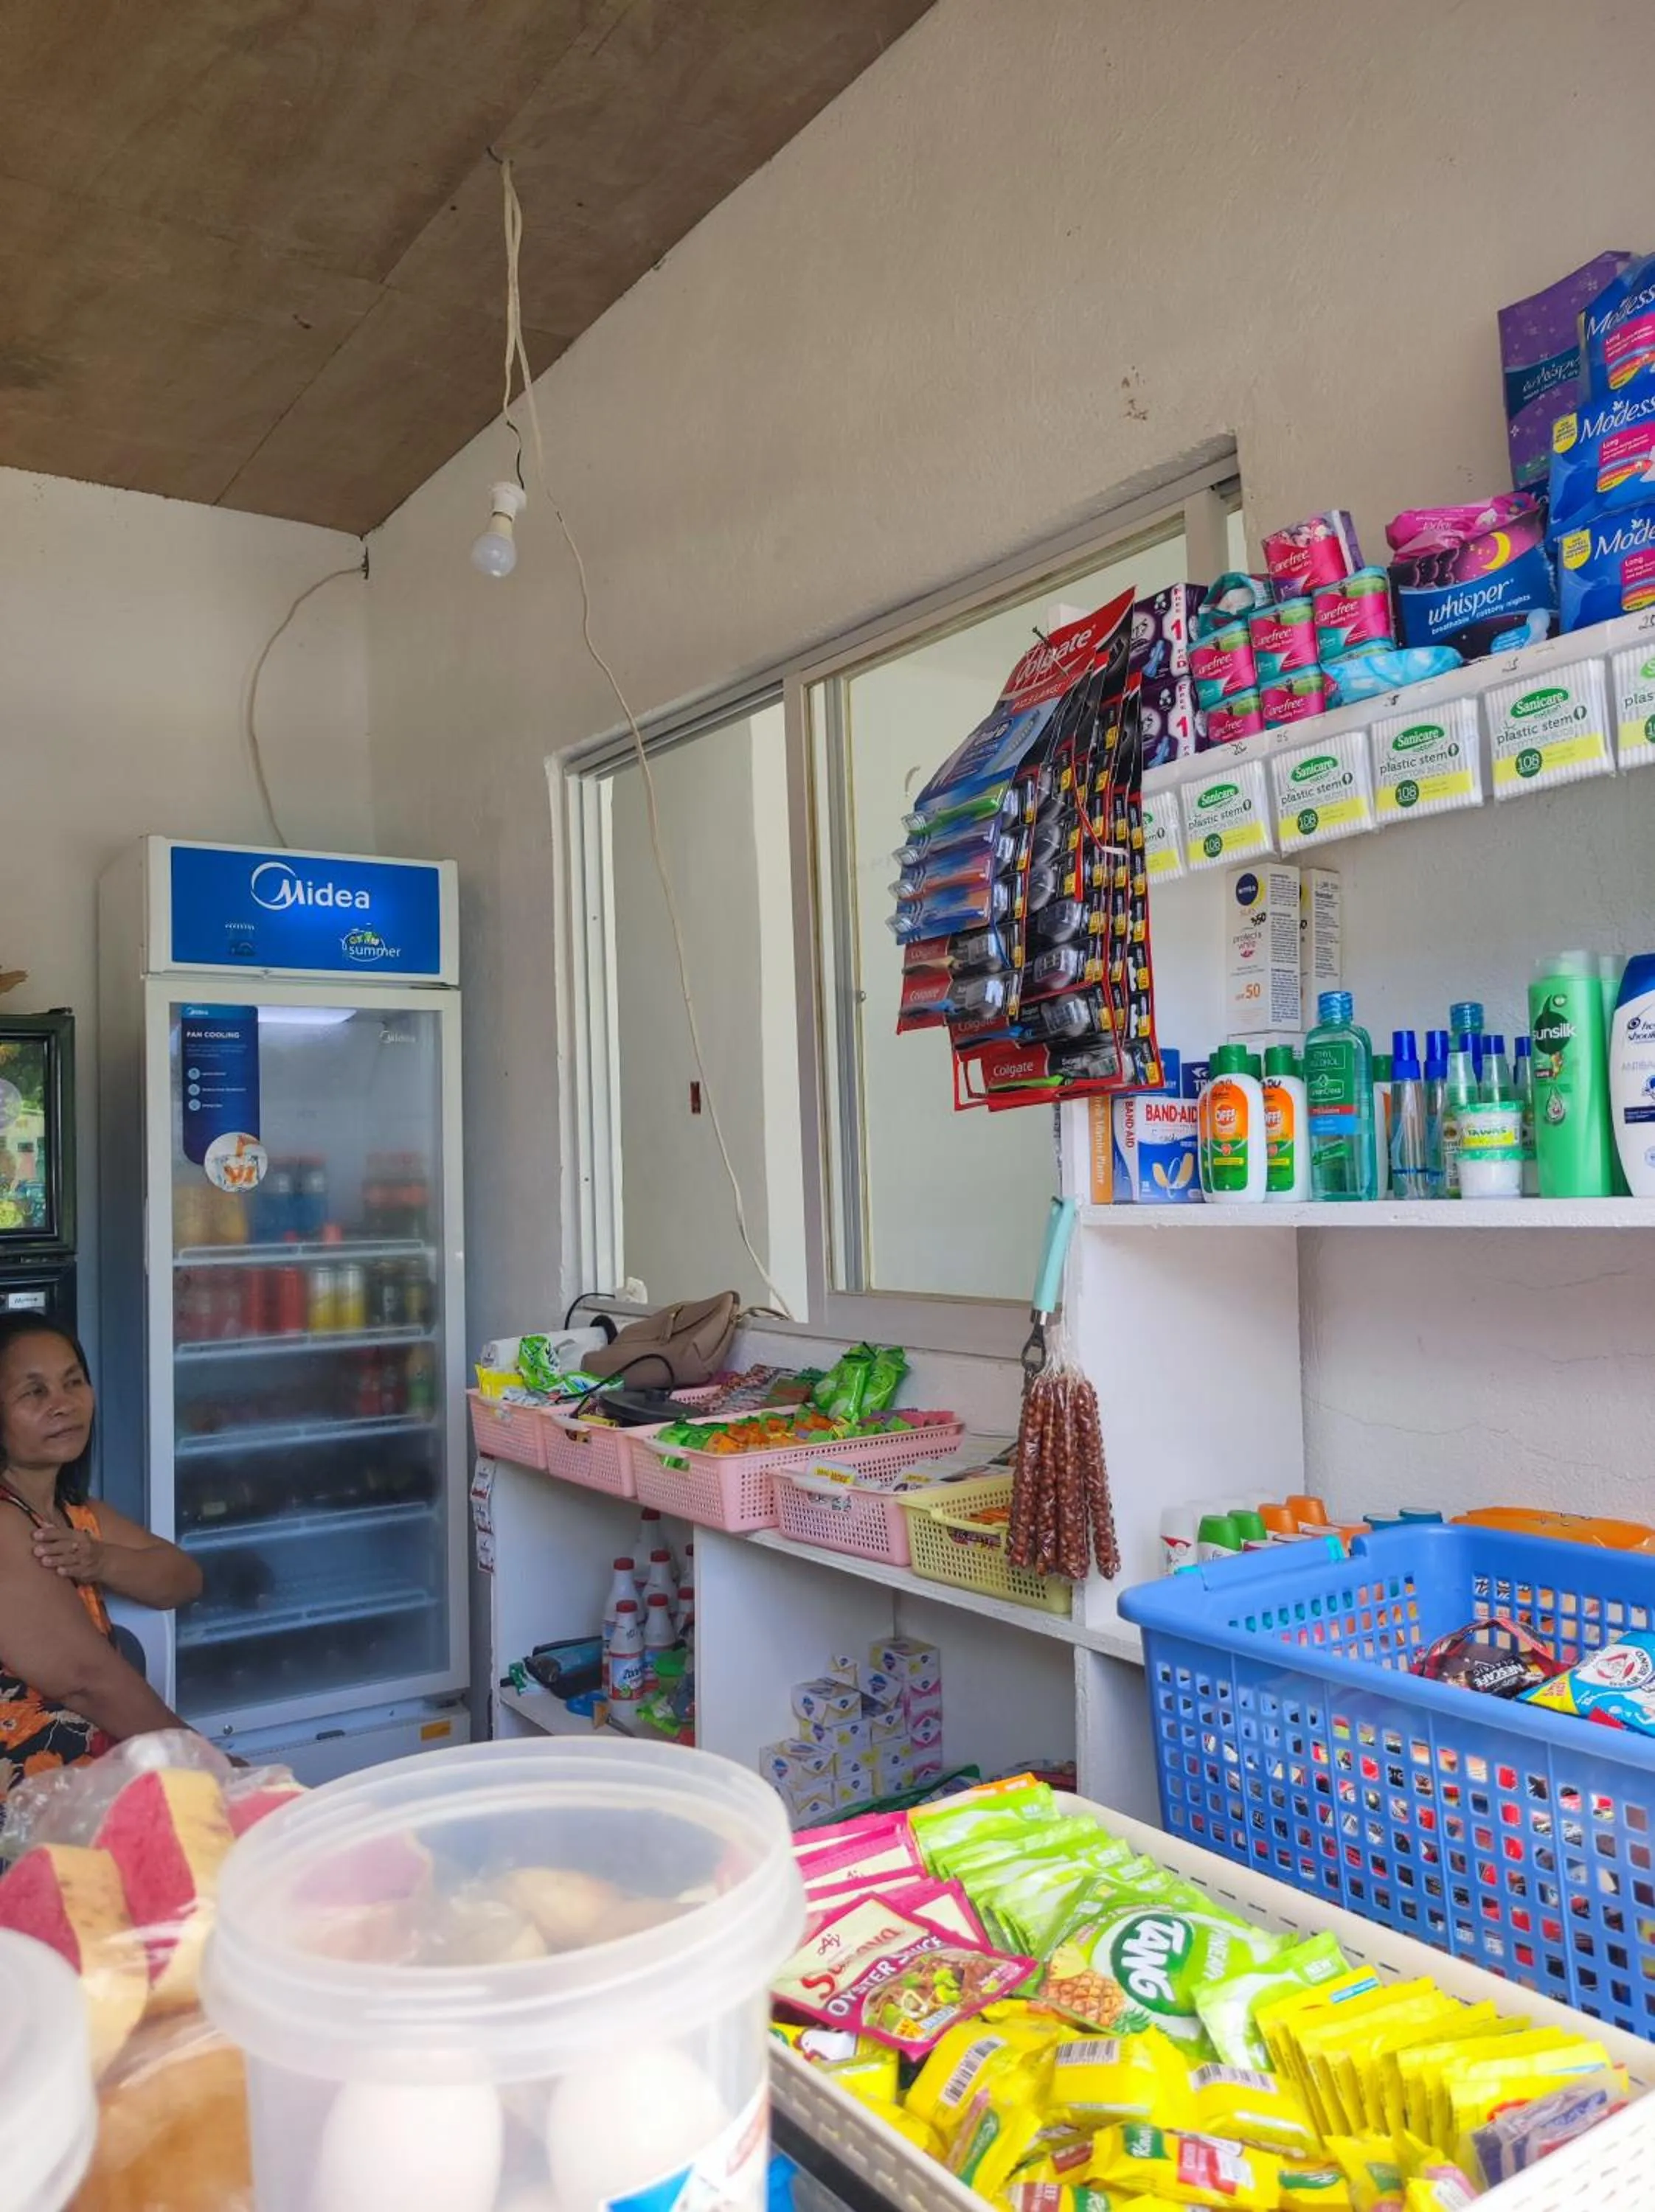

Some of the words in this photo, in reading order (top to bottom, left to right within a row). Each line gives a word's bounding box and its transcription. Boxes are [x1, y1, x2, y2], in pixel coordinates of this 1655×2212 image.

[1429, 580, 1510, 625] whisper
[1506, 594, 1531, 608] nights
[1515, 691, 1564, 715] Sanicare
[1397, 727, 1440, 748] Sanicare
[1496, 723, 1538, 746] plastic
[1541, 713, 1574, 731] stem
[1294, 759, 1334, 777] Sanicare
[1379, 758, 1417, 776] plastic
[1419, 751, 1448, 765] stem
[1517, 754, 1540, 773] 108
[1200, 787, 1238, 806] Sanicare
[1281, 788, 1316, 806] plastic
[1316, 780, 1342, 795] stem
[1397, 784, 1418, 801] 108
[1188, 814, 1219, 831] plastic
[1221, 807, 1244, 821] stem
[250, 861, 369, 911] Midea
[348, 945, 401, 958] summer
[1245, 983, 1260, 999] 50
[993, 1061, 1035, 1079] Colgate
[1120, 1919, 1187, 2003] TANG
[826, 1956, 897, 2017] OYSTER
